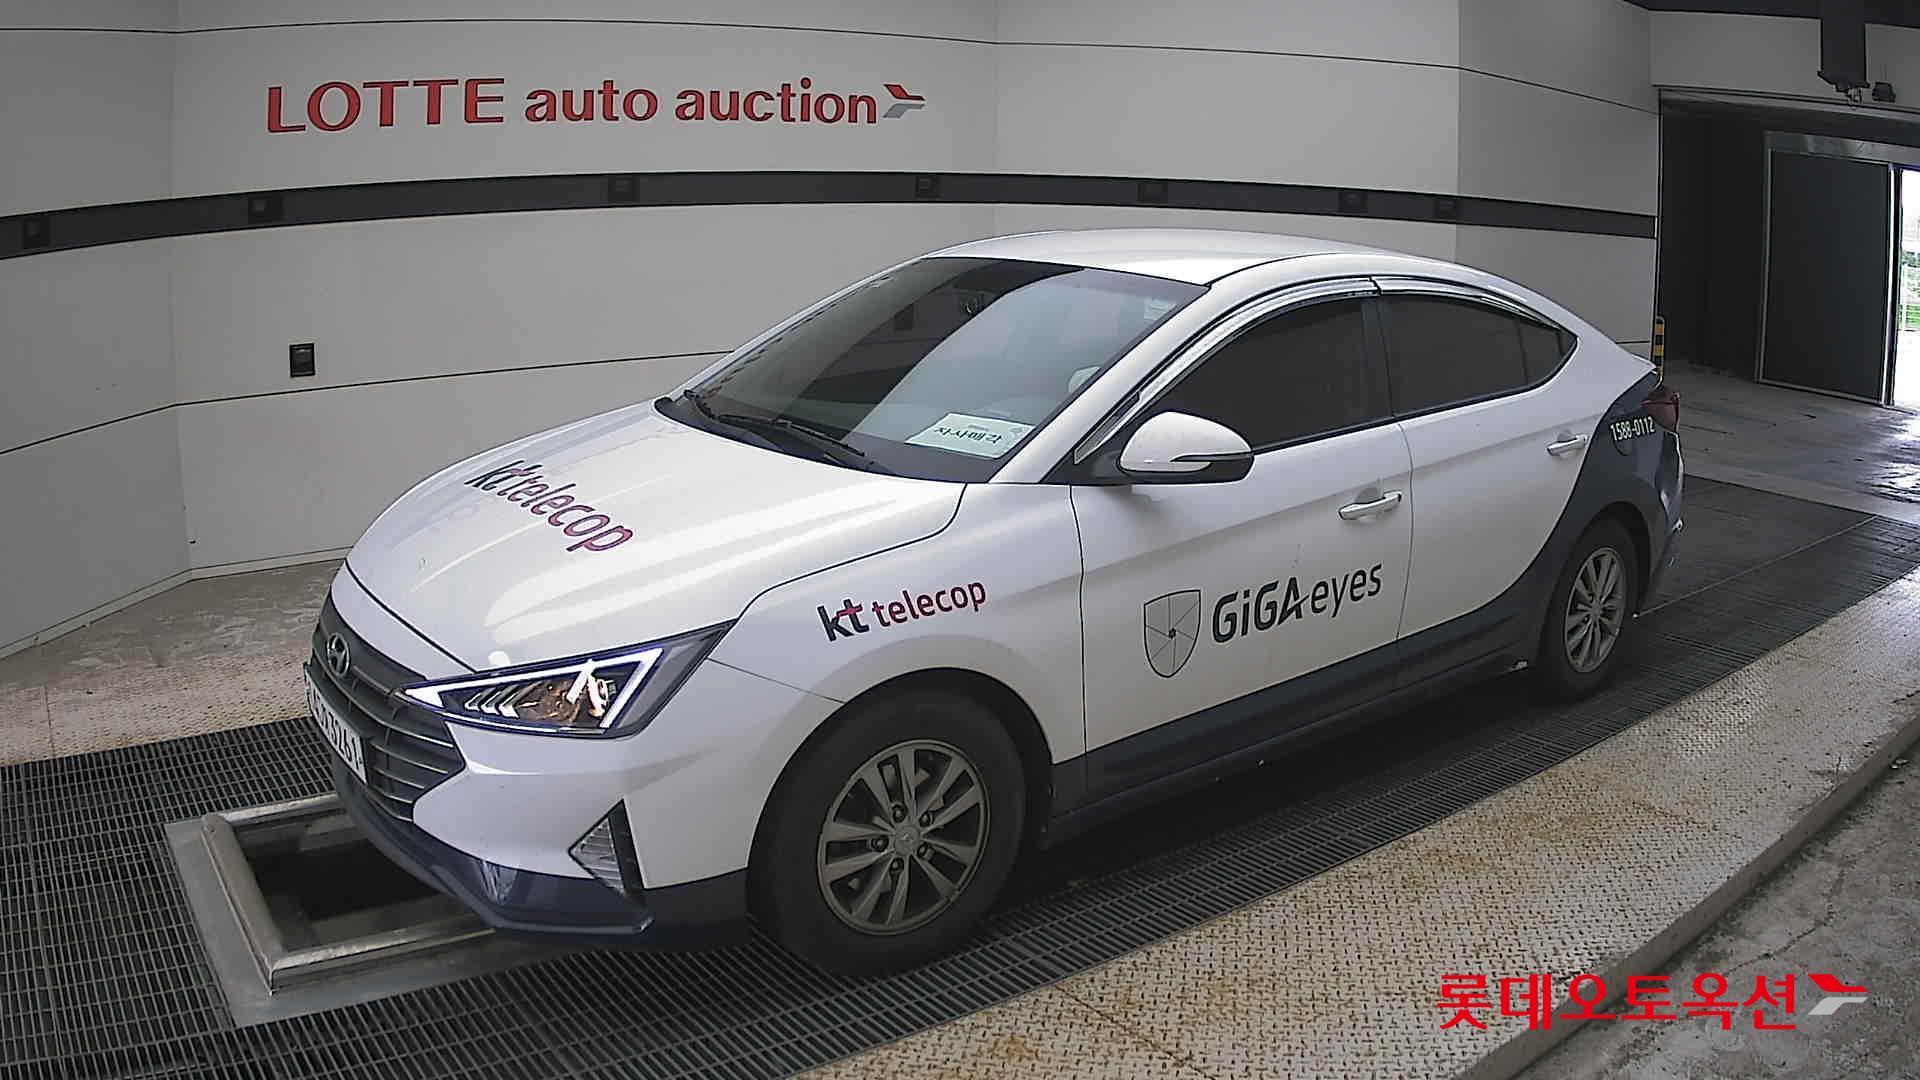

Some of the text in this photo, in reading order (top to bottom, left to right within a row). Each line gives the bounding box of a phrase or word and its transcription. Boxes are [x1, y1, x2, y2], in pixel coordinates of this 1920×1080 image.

[267, 77, 877, 132] LOTTE auto auction
[1610, 416, 1655, 441] 1588-0112
[464, 459, 633, 552] kt telecop
[816, 582, 986, 642] kt telecop
[1212, 563, 1382, 643] GiGA eyes
